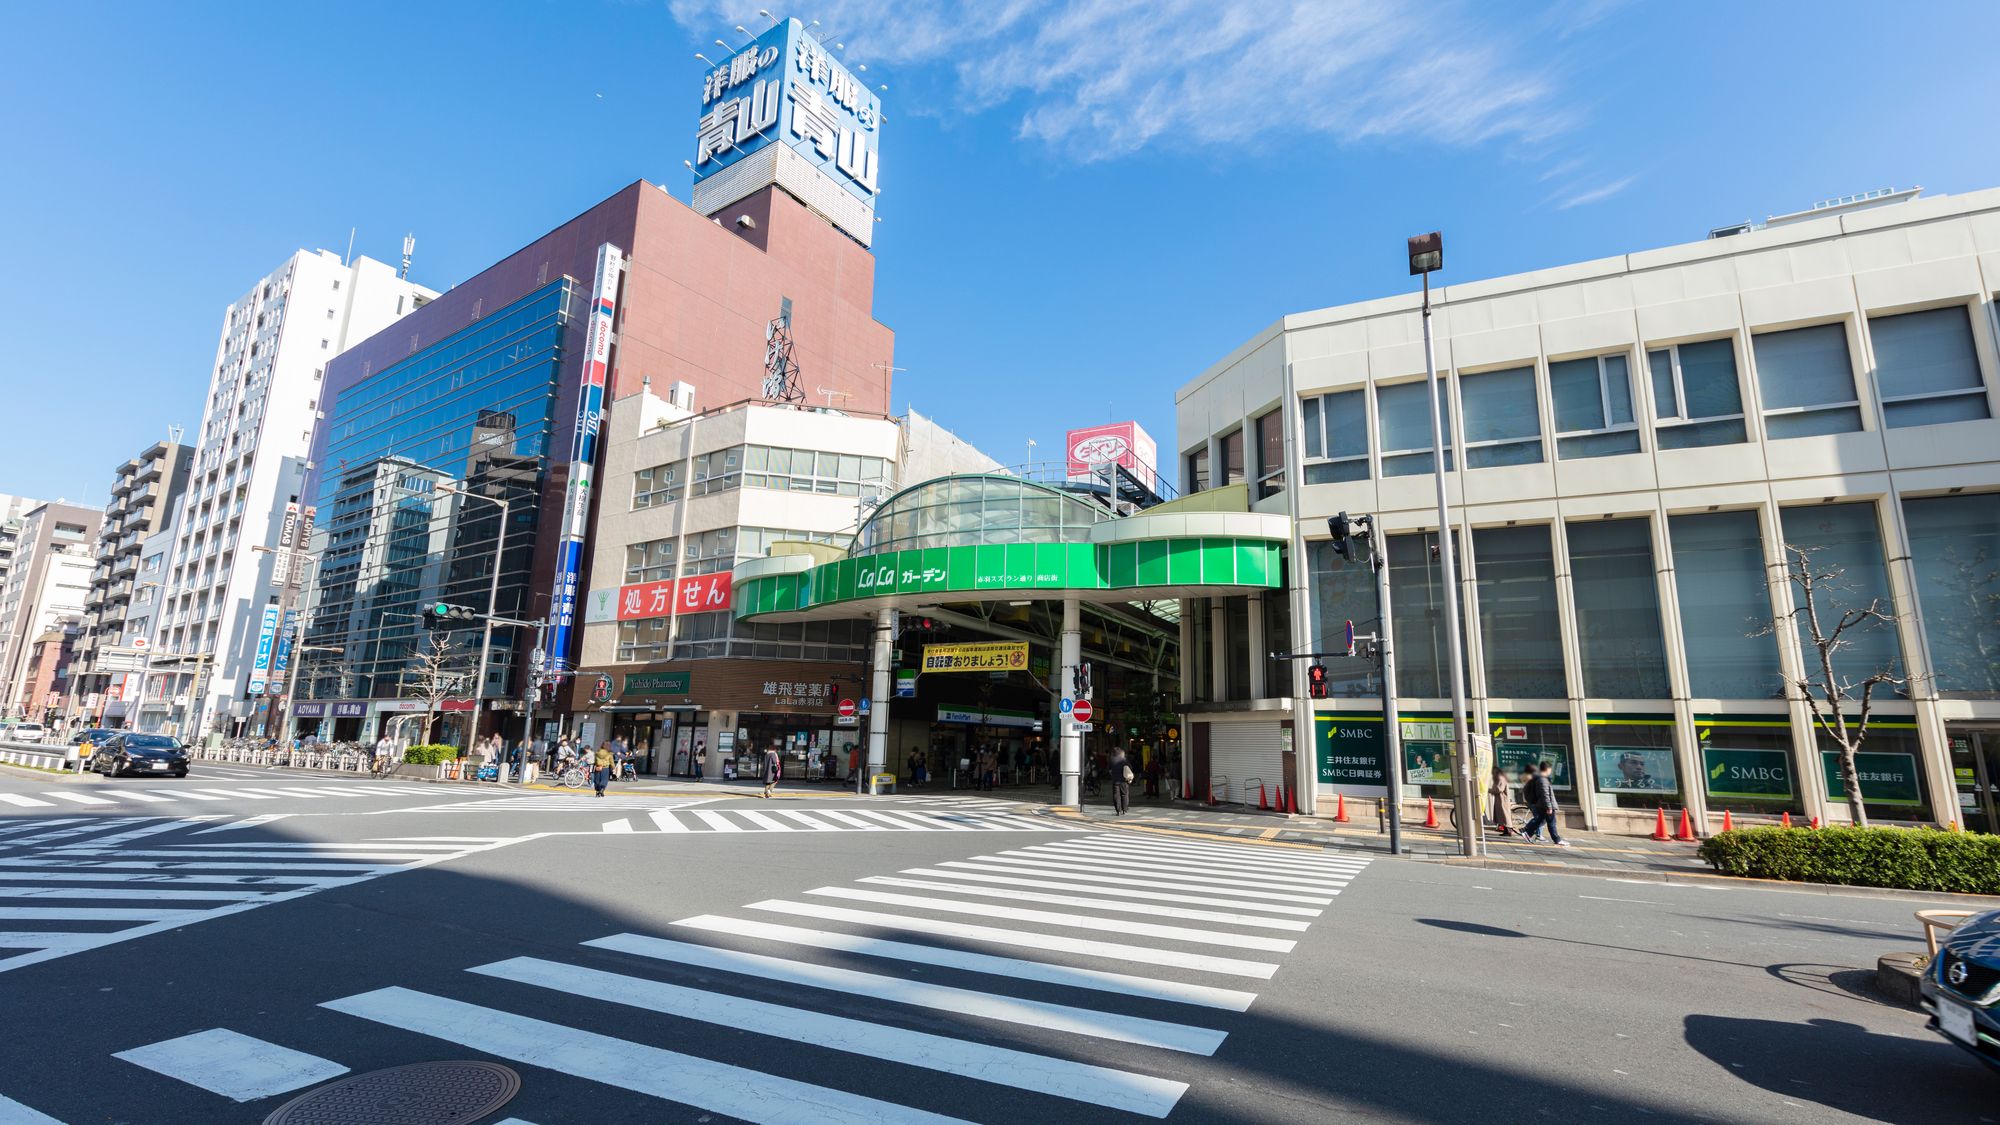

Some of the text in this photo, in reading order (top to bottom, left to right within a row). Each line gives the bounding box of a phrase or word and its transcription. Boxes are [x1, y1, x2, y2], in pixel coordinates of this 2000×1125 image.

[703, 45, 779, 104] 洋服の
[796, 35, 878, 131] 洋服の
[696, 79, 780, 165] 青山
[787, 77, 879, 195] 青山
[597, 320, 609, 356] docomo
[585, 410, 599, 437] TBC
[282, 514, 296, 545] TOMAS
[902, 567, 946, 584] ガーデン
[1037, 574, 1058, 582] 商店街
[560, 571, 577, 627] 洋服の青山
[623, 578, 725, 615] 処方せん
[652, 679, 683, 690] Pharmacy
[298, 704, 320, 714] AOYAMA
[775, 697, 824, 707] LaLa赤羽店
[951, 712, 971, 721] FamilyMart
[1340, 728, 1373, 738] SMBC
[1326, 756, 1377, 765] 三井住友銀行
[1322, 768, 1382, 779] SMBC日興証券
[1731, 766, 1785, 781] SMBC
[1836, 772, 1904, 782] 三住友銀行
